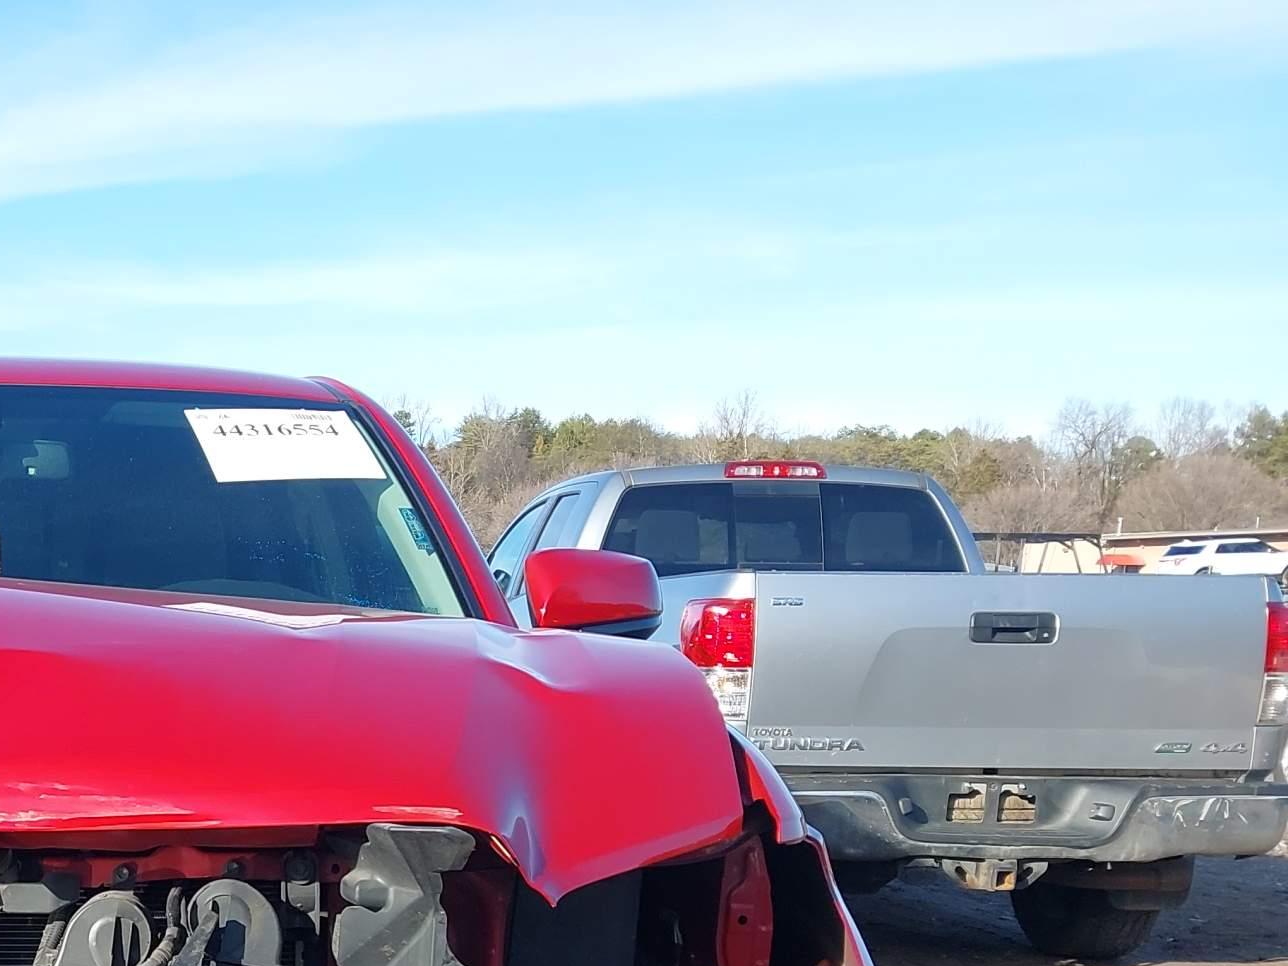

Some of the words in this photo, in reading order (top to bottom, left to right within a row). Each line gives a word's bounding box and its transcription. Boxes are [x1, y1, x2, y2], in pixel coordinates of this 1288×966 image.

[212, 423, 340, 437] 44316554
[752, 727, 794, 737] TOYOTA
[752, 737, 865, 752] TUNDRA
